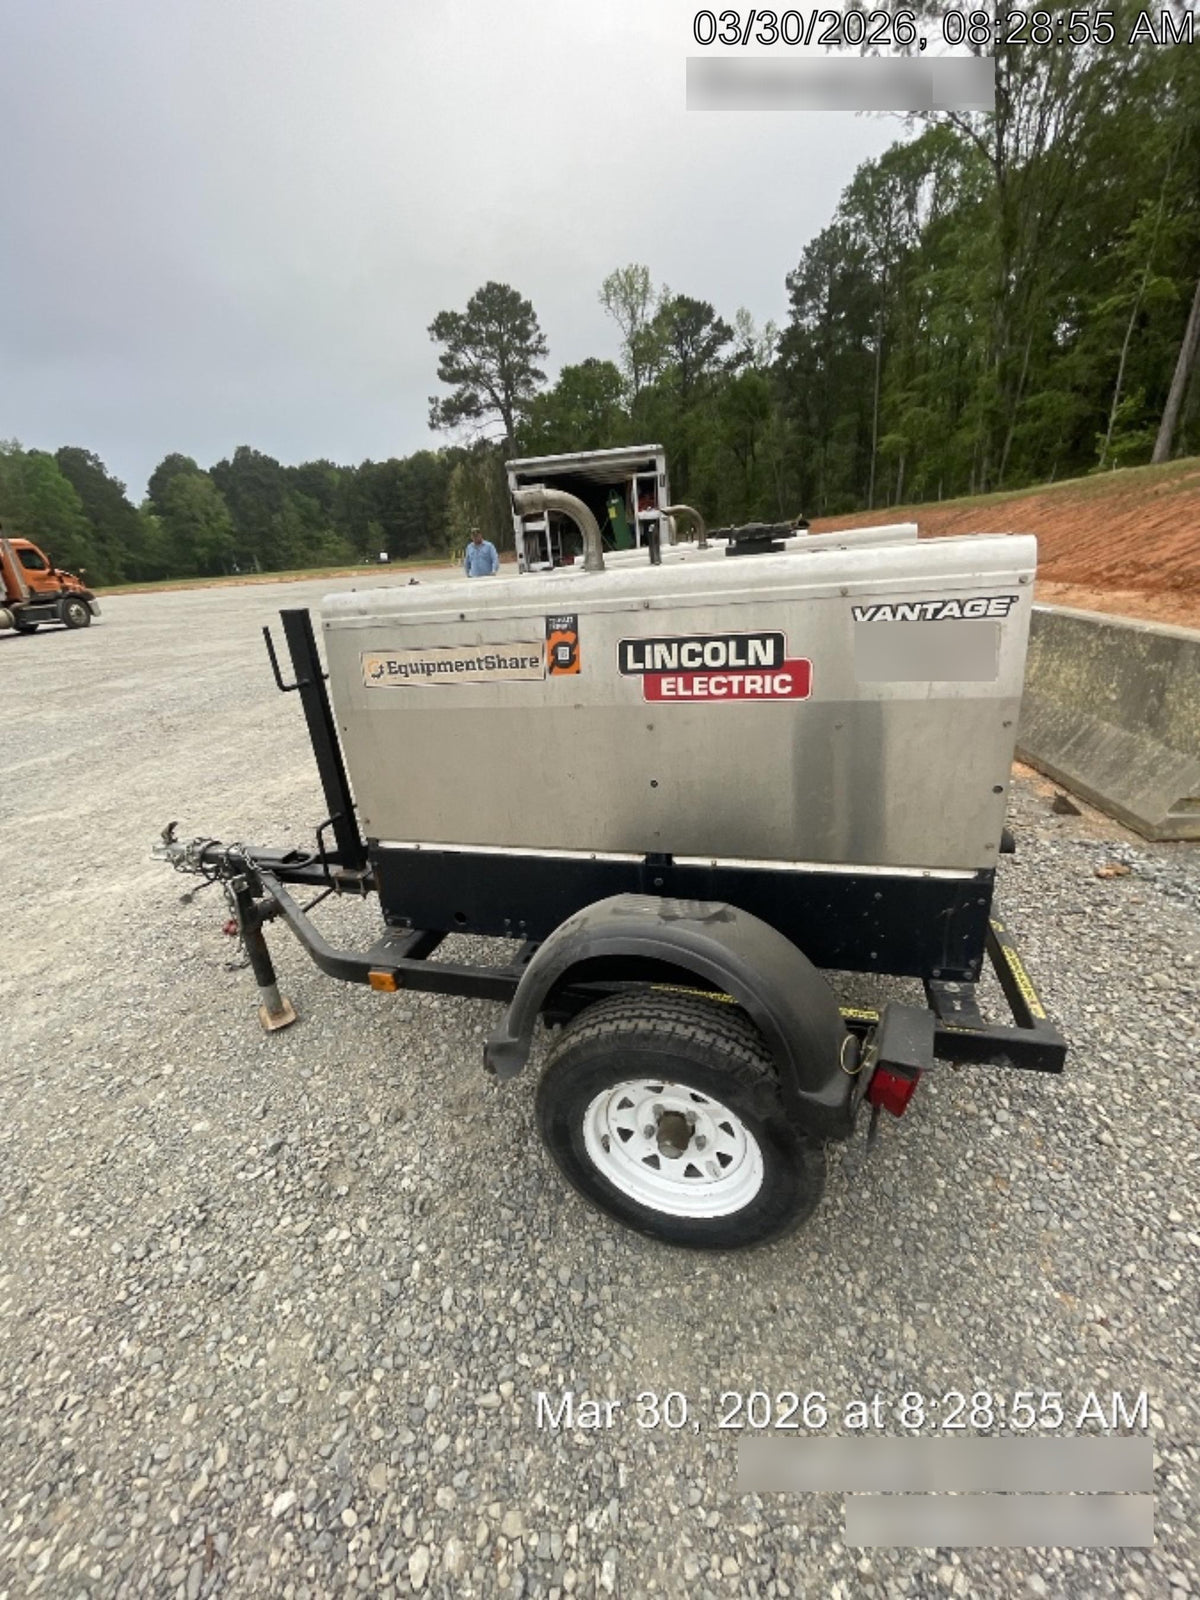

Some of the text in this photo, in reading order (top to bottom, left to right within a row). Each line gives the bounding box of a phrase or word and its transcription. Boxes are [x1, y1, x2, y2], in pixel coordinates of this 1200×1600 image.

[852, 596, 1014, 622] VANTAGE
[626, 638, 775, 670] LINCOLN
[386, 655, 540, 678] EquipmentShare
[660, 674, 792, 697] ELECTRIC
